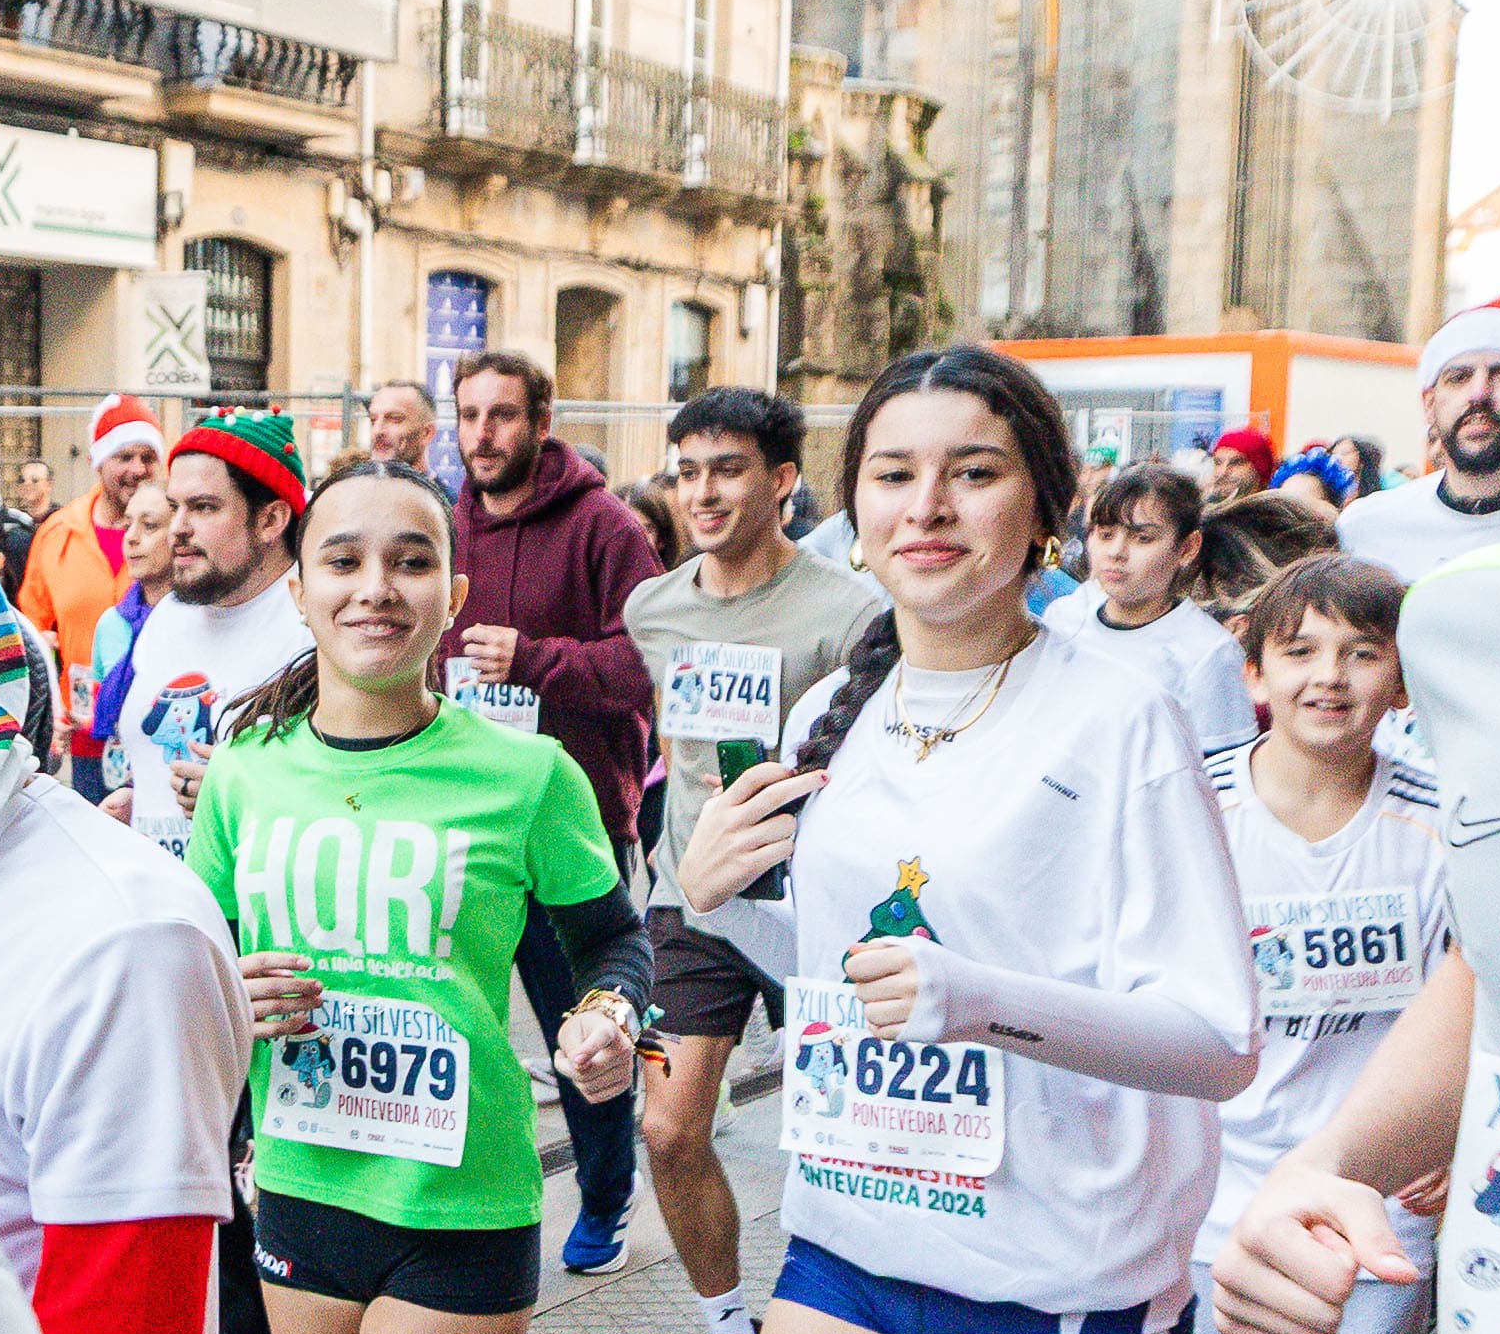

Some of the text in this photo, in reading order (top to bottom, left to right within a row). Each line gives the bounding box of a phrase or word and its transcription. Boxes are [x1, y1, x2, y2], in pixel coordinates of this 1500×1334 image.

[145, 371, 201, 386] codex
[709, 671, 771, 707] 5744
[234, 817, 471, 958] HQR!
[1276, 900, 1311, 926] SAN
[1315, 892, 1408, 924] SILVESTRE
[1304, 921, 1406, 970] 5861
[1300, 966, 1414, 992] PONTEVEDRA 2025
[322, 998, 356, 1033] SAN
[362, 1004, 458, 1044] SILVESTRE
[796, 986, 829, 1023] XLII
[342, 1037, 457, 1101] 6979
[856, 1037, 990, 1107] 6224
[338, 1093, 457, 1132] PONTEVEDRA 2025
[852, 1102, 992, 1140] PONTEVEDRA 2025
[927, 1188, 987, 1219] 2024
